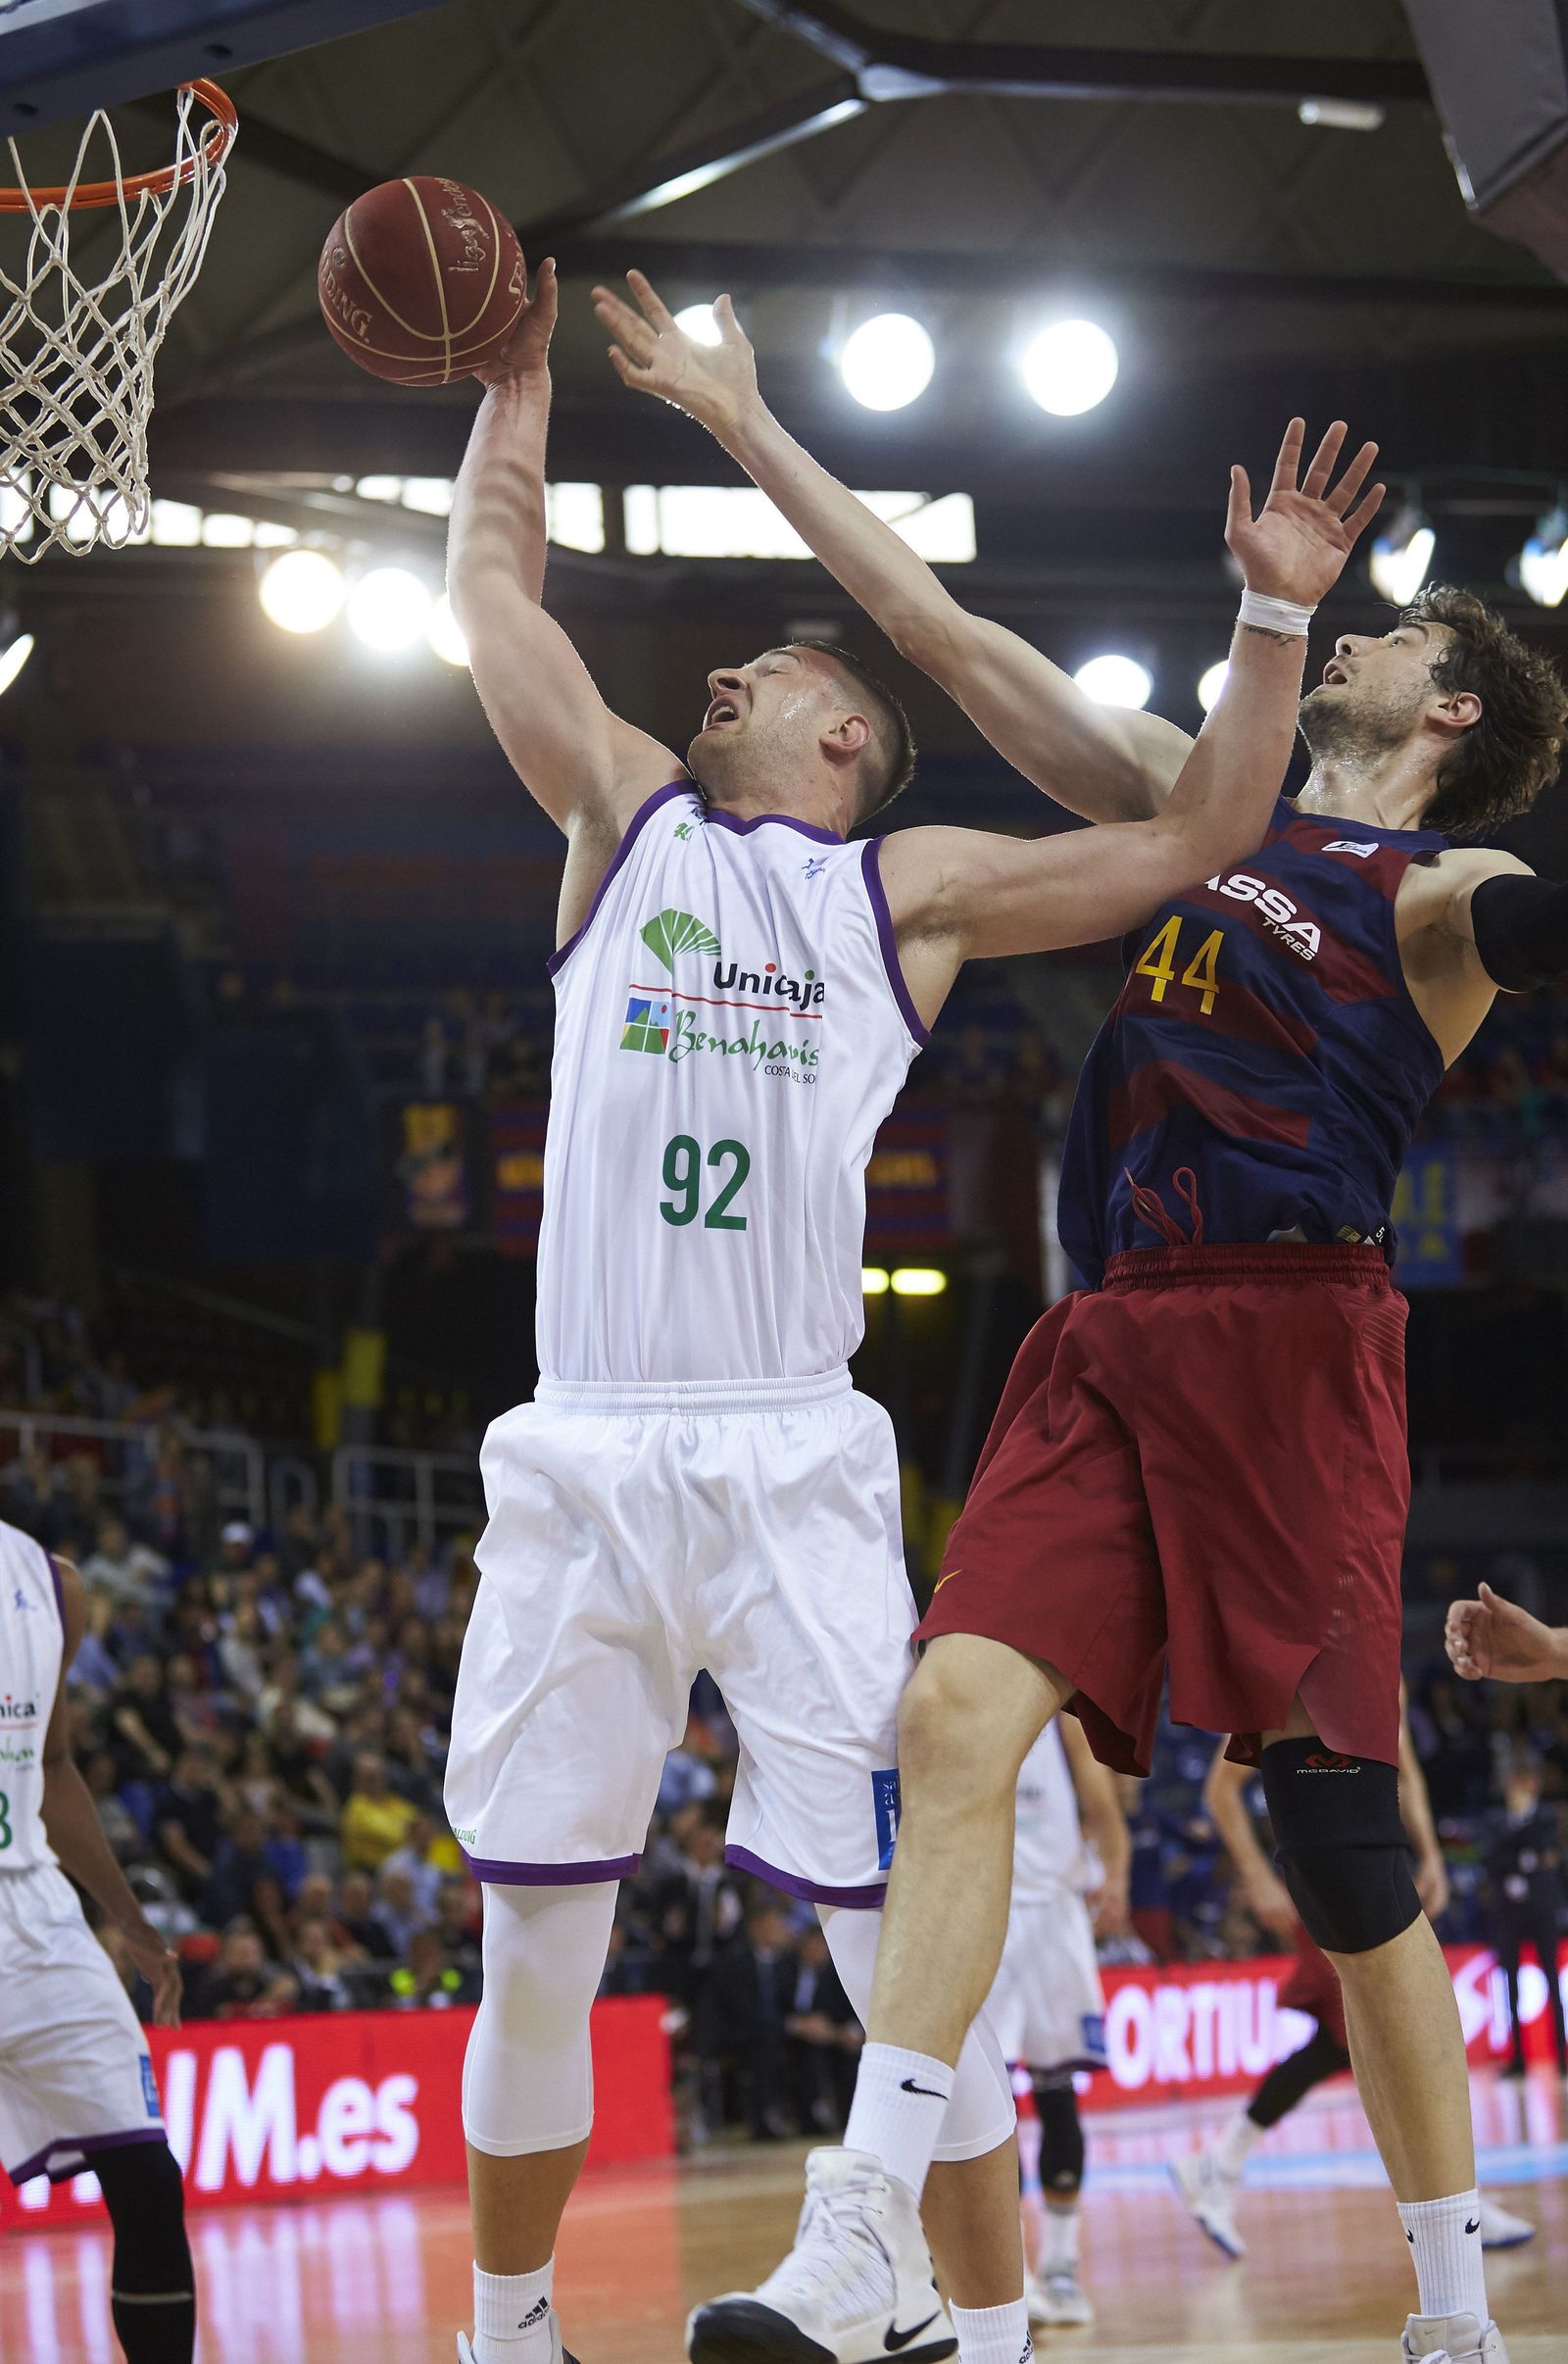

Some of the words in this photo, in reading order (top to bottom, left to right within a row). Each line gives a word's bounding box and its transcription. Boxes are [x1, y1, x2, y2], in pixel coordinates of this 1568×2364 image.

[1203, 873, 1321, 955] SSA
[1262, 916, 1315, 961] TYRES
[713, 960, 825, 1011] Unicaja
[1135, 914, 1225, 1015] 44
[764, 1064, 791, 1077] COSTA
[803, 1073, 816, 1084] SO
[660, 1134, 751, 1231] 92
[1105, 1976, 1319, 2091] ORTIU
